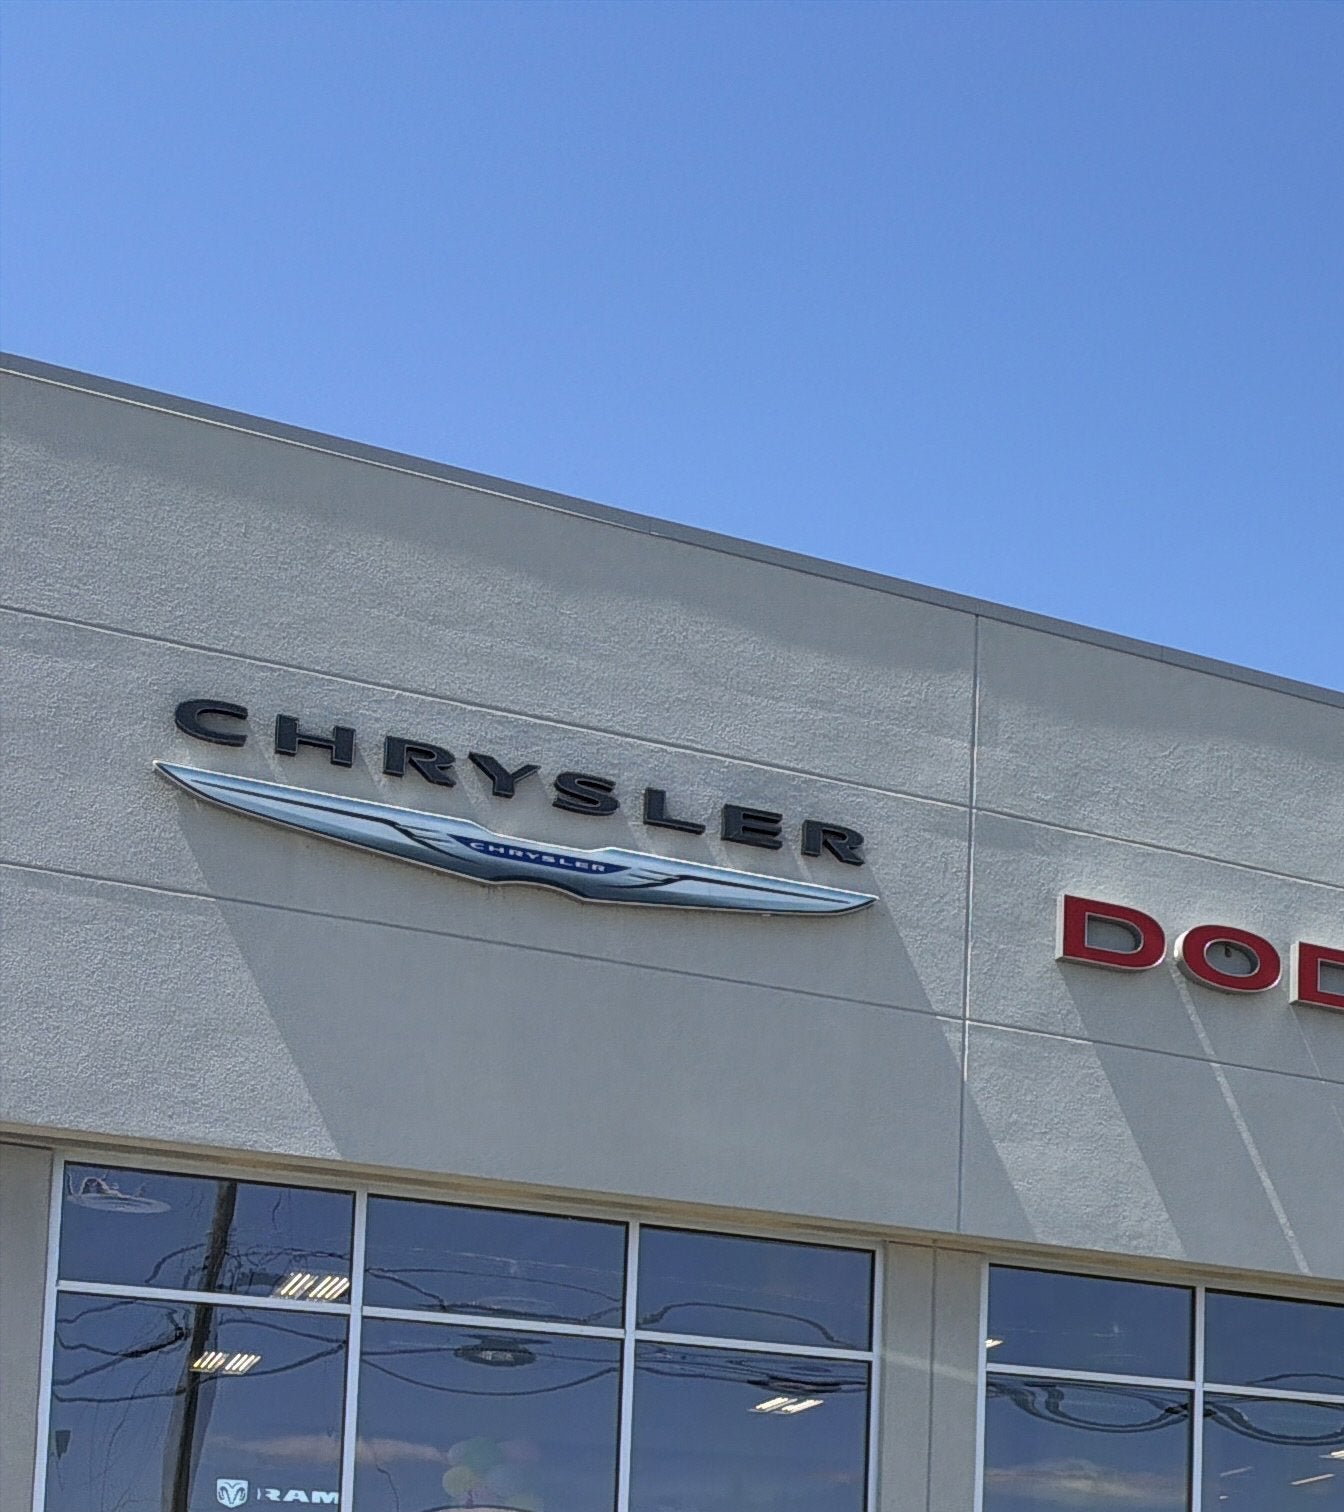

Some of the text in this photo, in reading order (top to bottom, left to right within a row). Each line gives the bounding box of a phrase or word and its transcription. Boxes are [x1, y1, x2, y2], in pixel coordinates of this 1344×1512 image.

[175, 699, 865, 867] CHRYSLER
[470, 841, 607, 873] CHRYSLER
[257, 1488, 339, 1504] RAM
